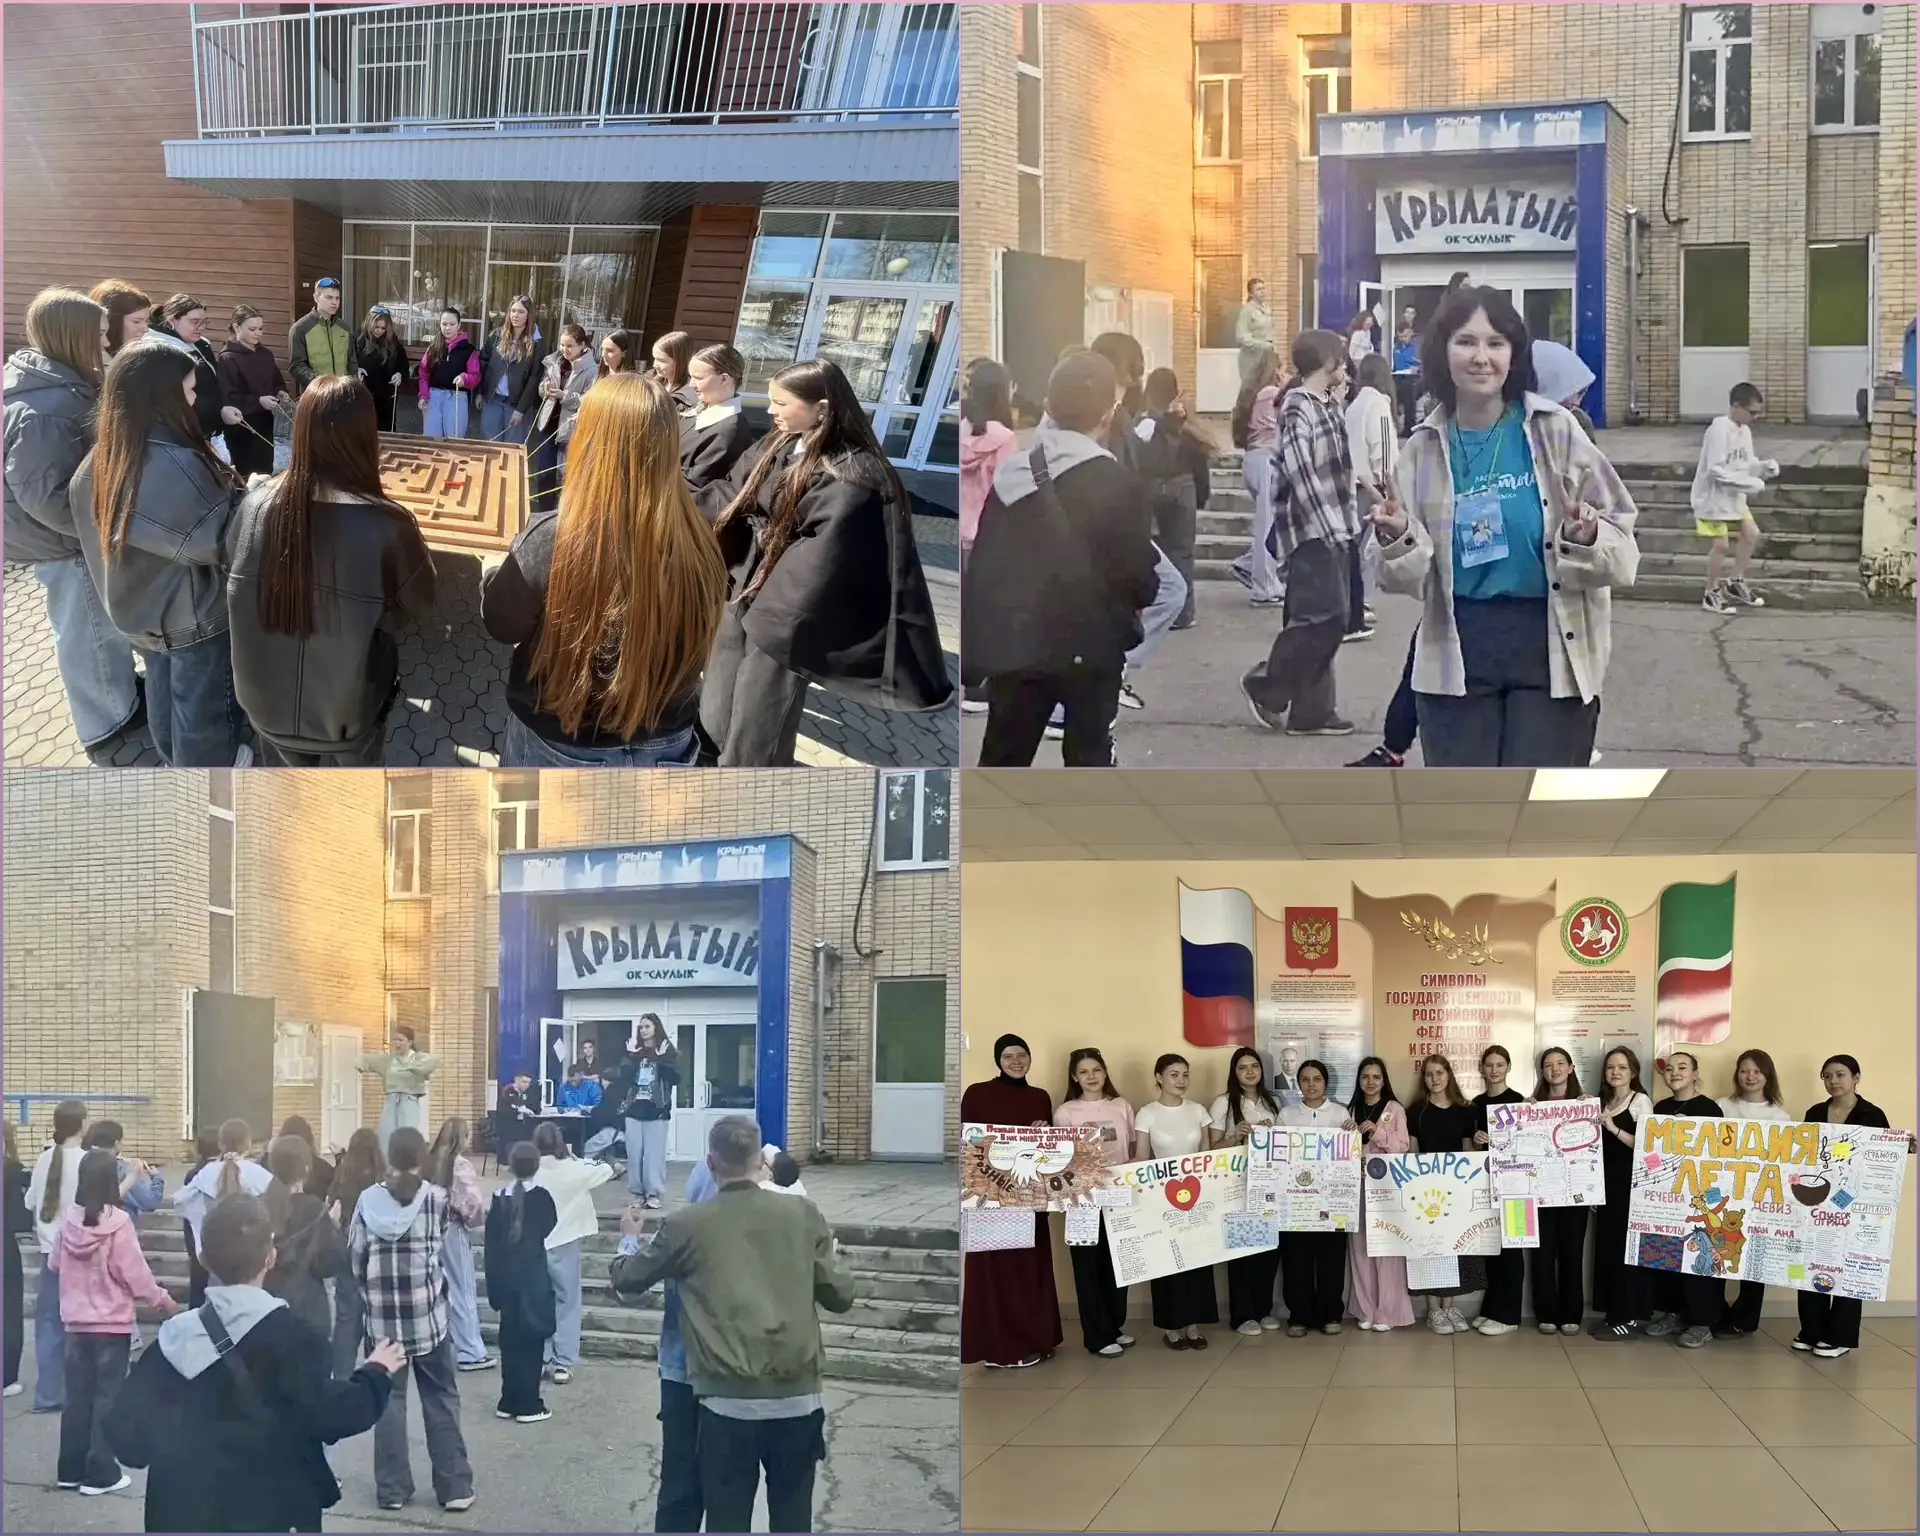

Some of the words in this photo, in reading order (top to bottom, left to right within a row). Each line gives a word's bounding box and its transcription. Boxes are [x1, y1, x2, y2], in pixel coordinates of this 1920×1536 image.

[1383, 187, 1578, 242] КРЫЛАТЫЙ
[1444, 234, 1460, 244] ОК
[626, 970, 642, 980] ОК
[1421, 974, 1487, 987] СИМВОЛЫ
[1386, 991, 1521, 1006] ГОСУДАРСТВЕННОСТИ
[1412, 1006, 1494, 1021] РОССИЙСКОЙ
[1416, 1026, 1491, 1039] ФЕДЕРАЦИИ
[1409, 1043, 1416, 1055] И
[1420, 1043, 1432, 1055] ЕЕ
[1250, 1130, 1361, 1162] ЧЕРЕМША
[974, 1145, 1015, 1193] ГРОЗНЫЕ
[1671, 1159, 1784, 1205] ЛЕТА
[1644, 1189, 1686, 1204] РЕЧЕВКА
[1751, 1201, 1792, 1215] ДЕВИЗ
[1453, 1216, 1501, 1252] МЕРОПРИЯТИ
[1774, 1229, 1795, 1239] ДНЯ
